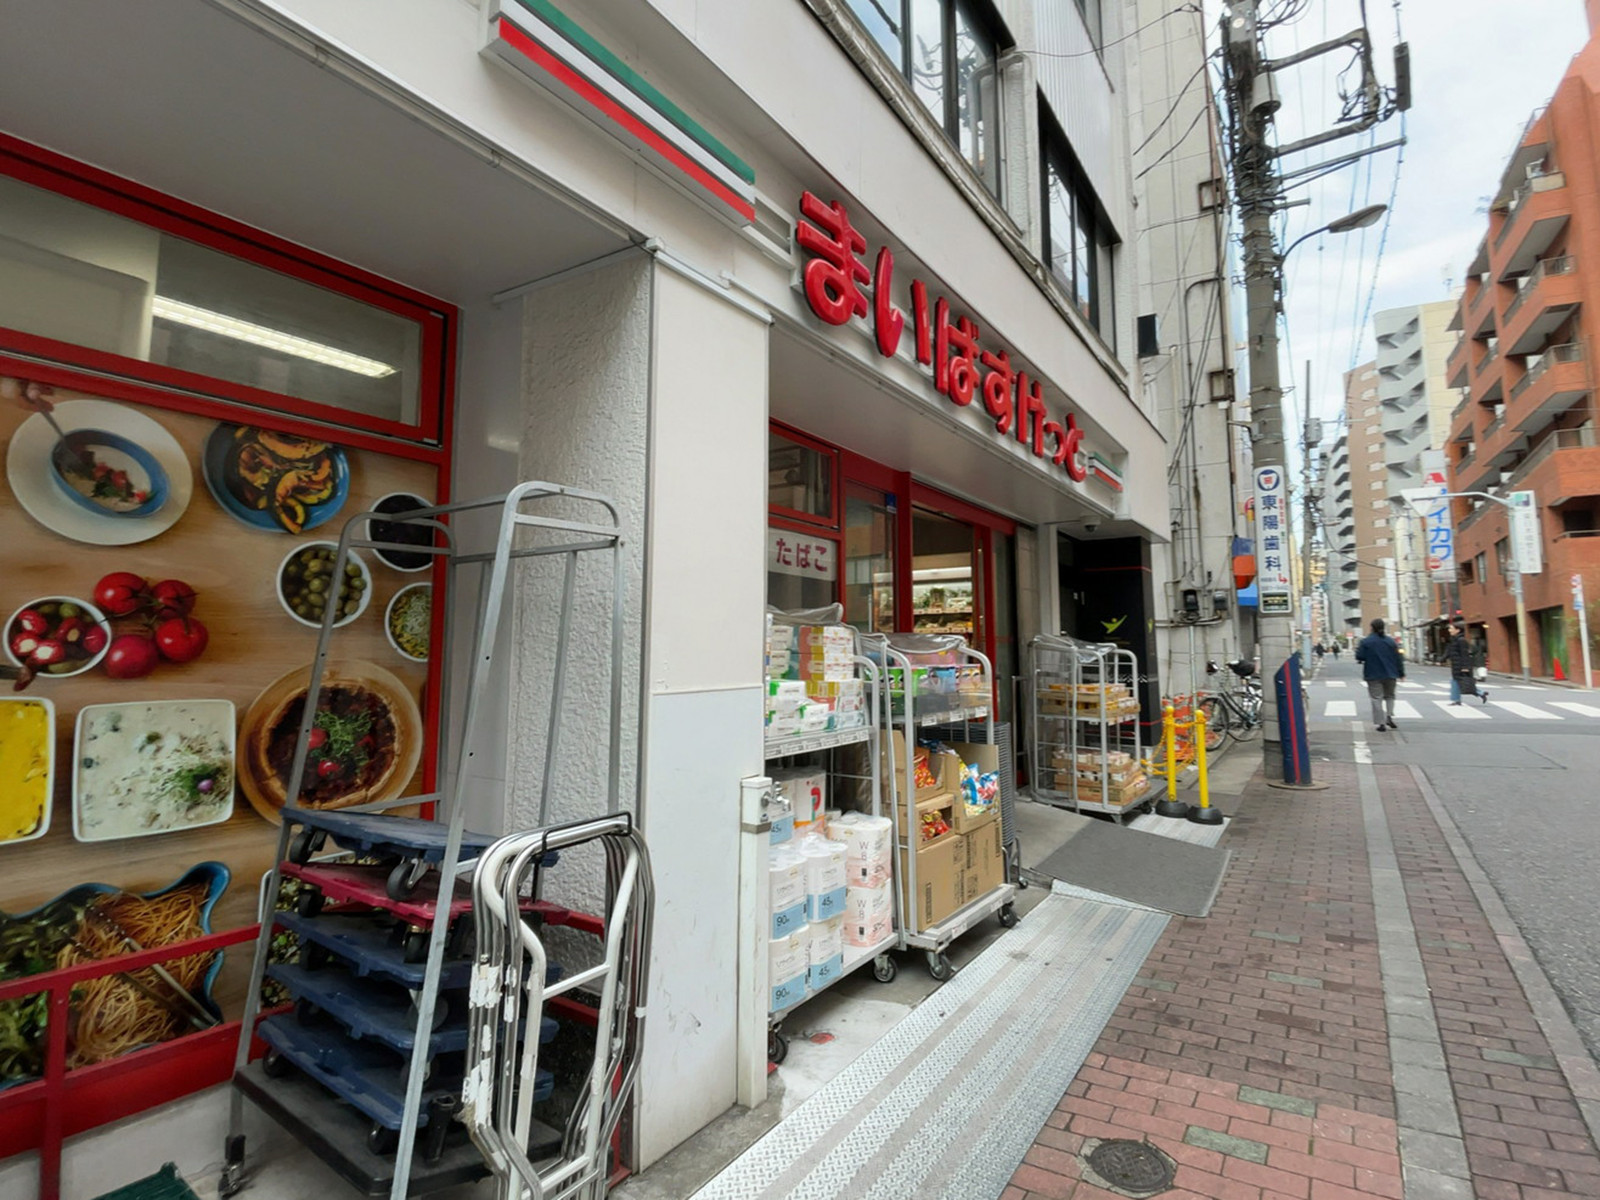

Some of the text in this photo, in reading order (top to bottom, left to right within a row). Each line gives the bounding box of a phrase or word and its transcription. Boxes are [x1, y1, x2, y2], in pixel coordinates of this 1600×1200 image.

[797, 190, 1086, 483] まいばすけっと
[776, 538, 828, 572] たばこ
